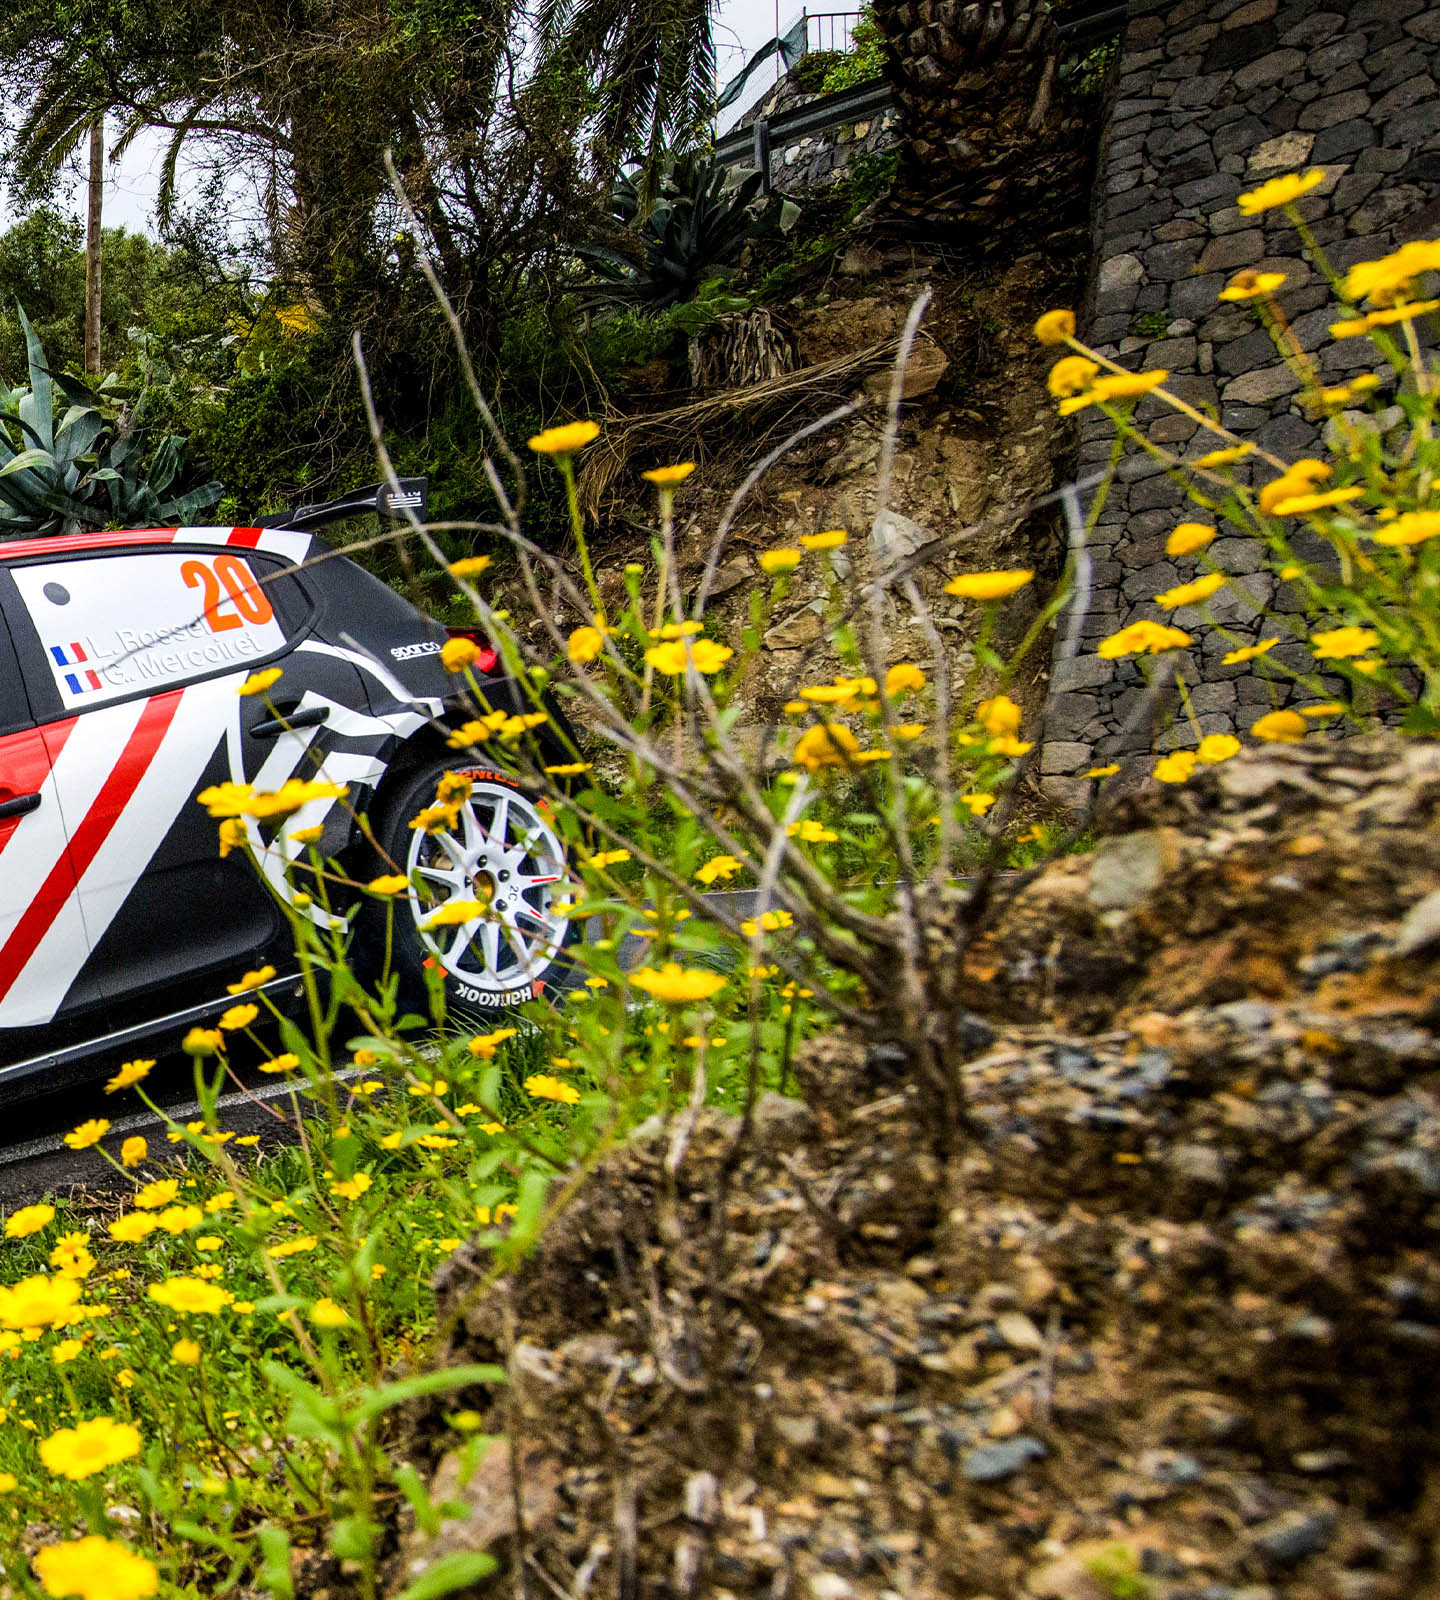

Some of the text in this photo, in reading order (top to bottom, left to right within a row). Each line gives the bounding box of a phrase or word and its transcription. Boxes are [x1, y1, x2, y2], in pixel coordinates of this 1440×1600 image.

[180, 554, 273, 633] 20
[133, 632, 264, 679] Mercoiret
[391, 642, 444, 661] sparco
